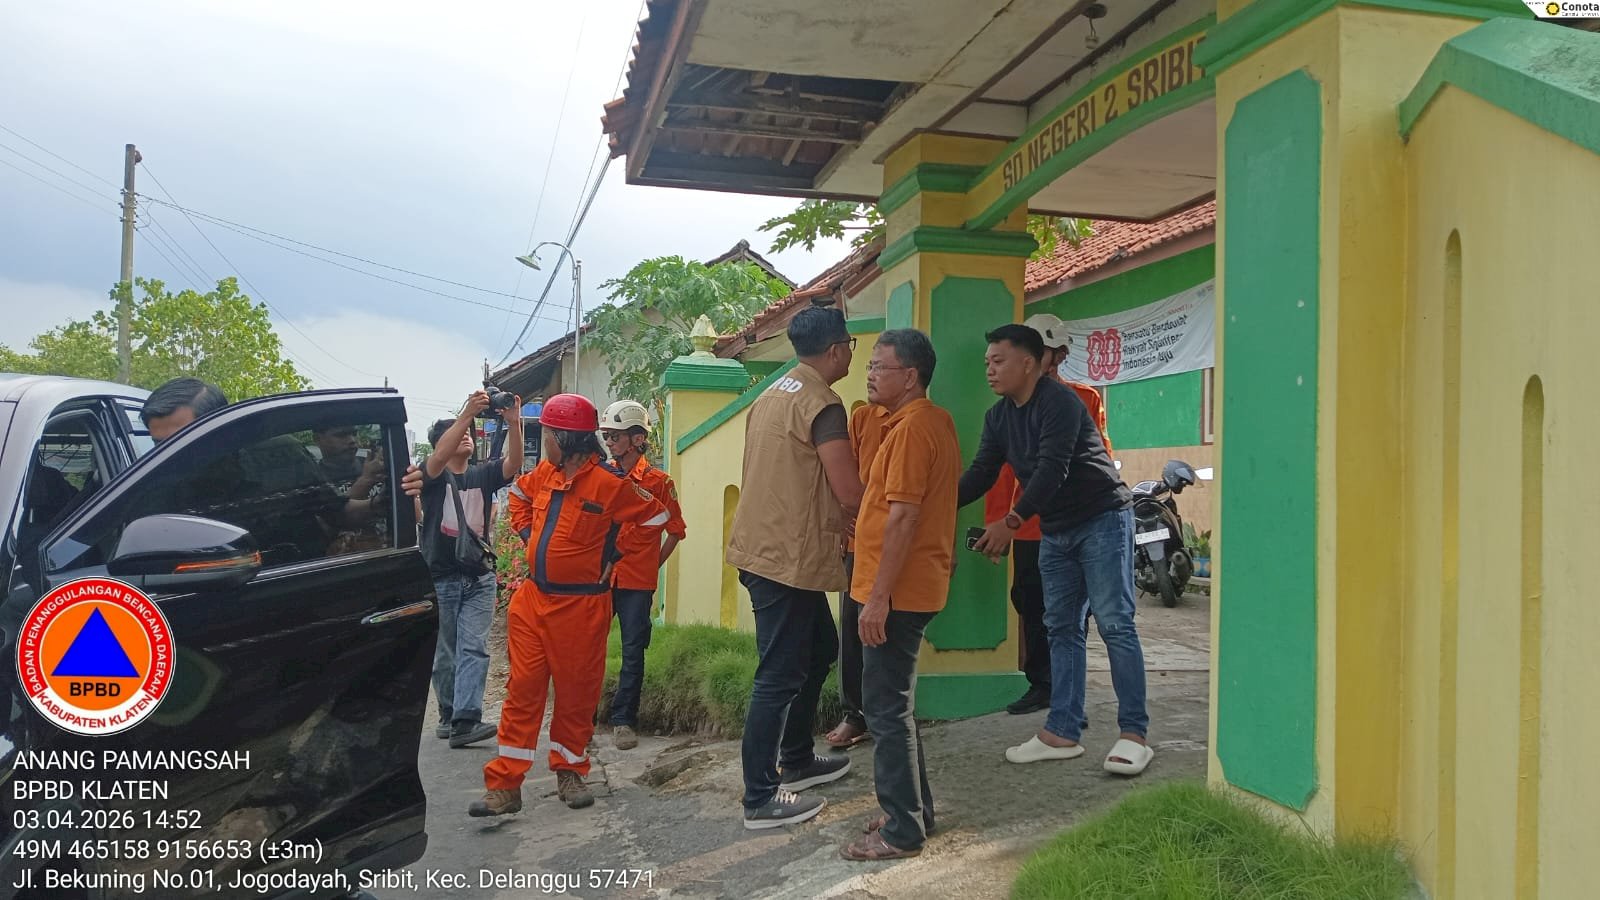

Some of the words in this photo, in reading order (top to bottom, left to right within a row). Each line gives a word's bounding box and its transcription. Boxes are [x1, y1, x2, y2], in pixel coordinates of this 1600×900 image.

[1003, 154, 1023, 192] SD
[1028, 95, 1096, 172] NEGERI
[1104, 83, 1118, 124] 2
